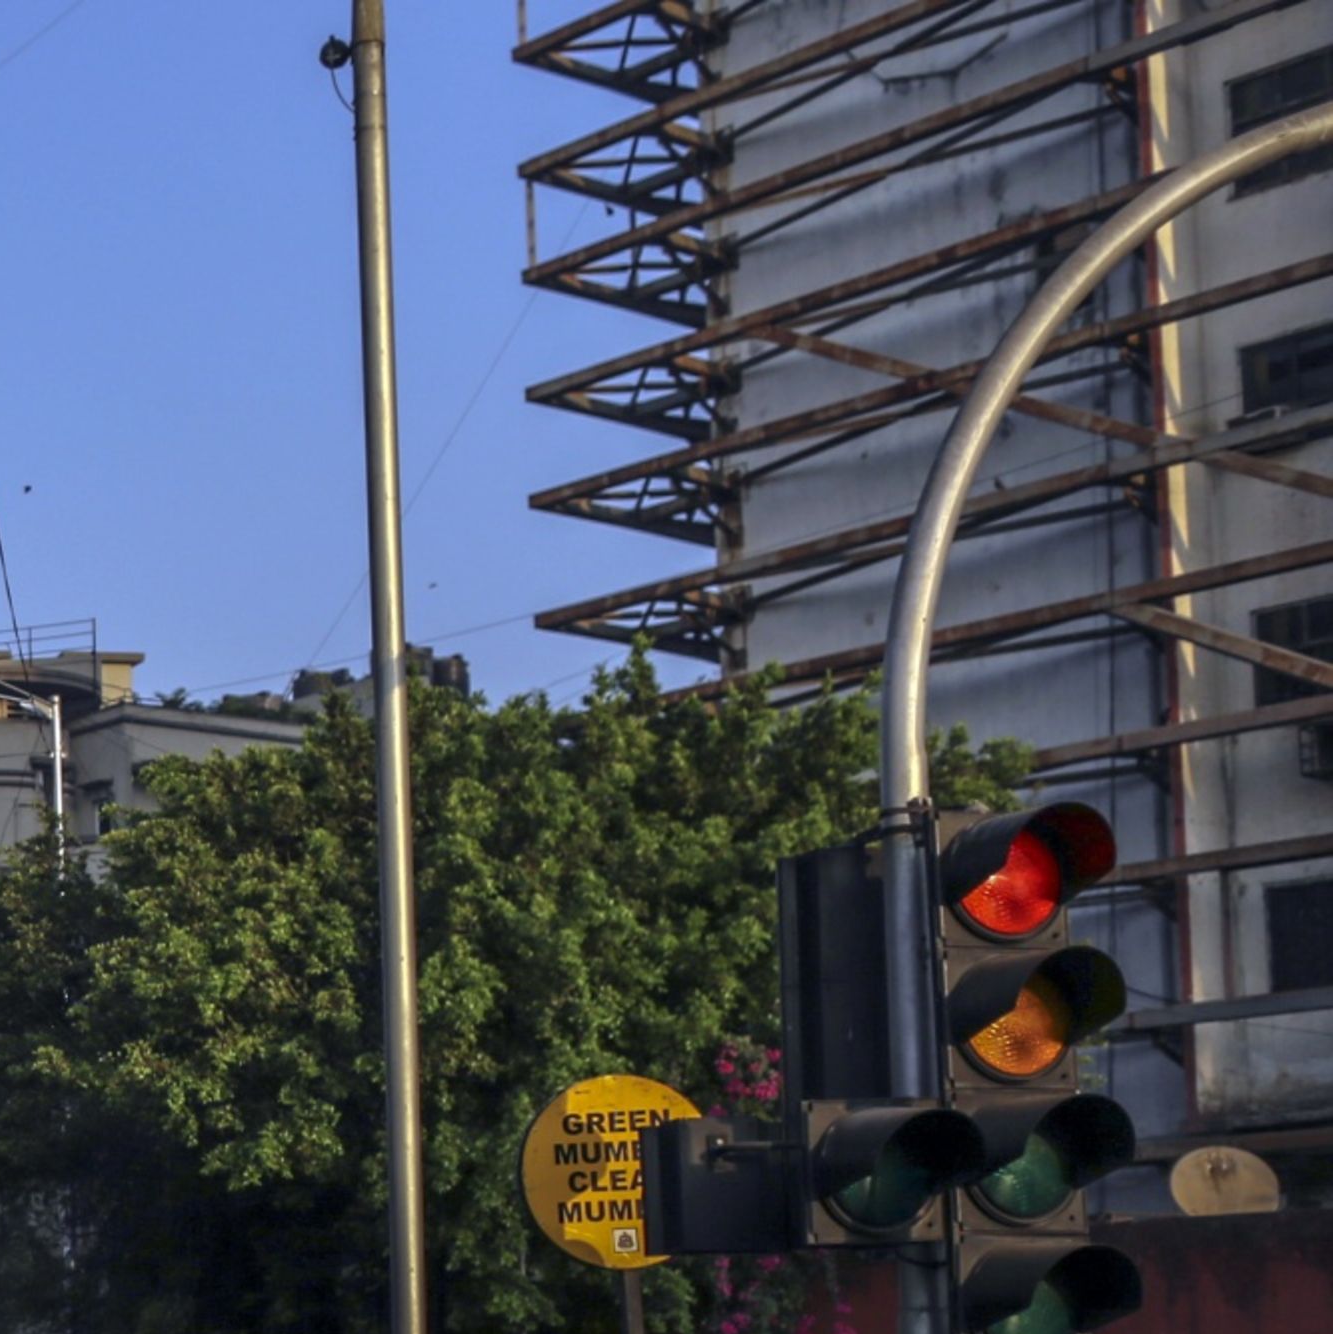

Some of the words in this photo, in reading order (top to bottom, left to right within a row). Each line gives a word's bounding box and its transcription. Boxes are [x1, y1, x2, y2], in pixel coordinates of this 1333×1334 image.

[562, 1109, 671, 1136] GREEN
[554, 1141, 642, 1165] MUM
[568, 1169, 646, 1193] CLEA
[558, 1199, 644, 1224] MUM
